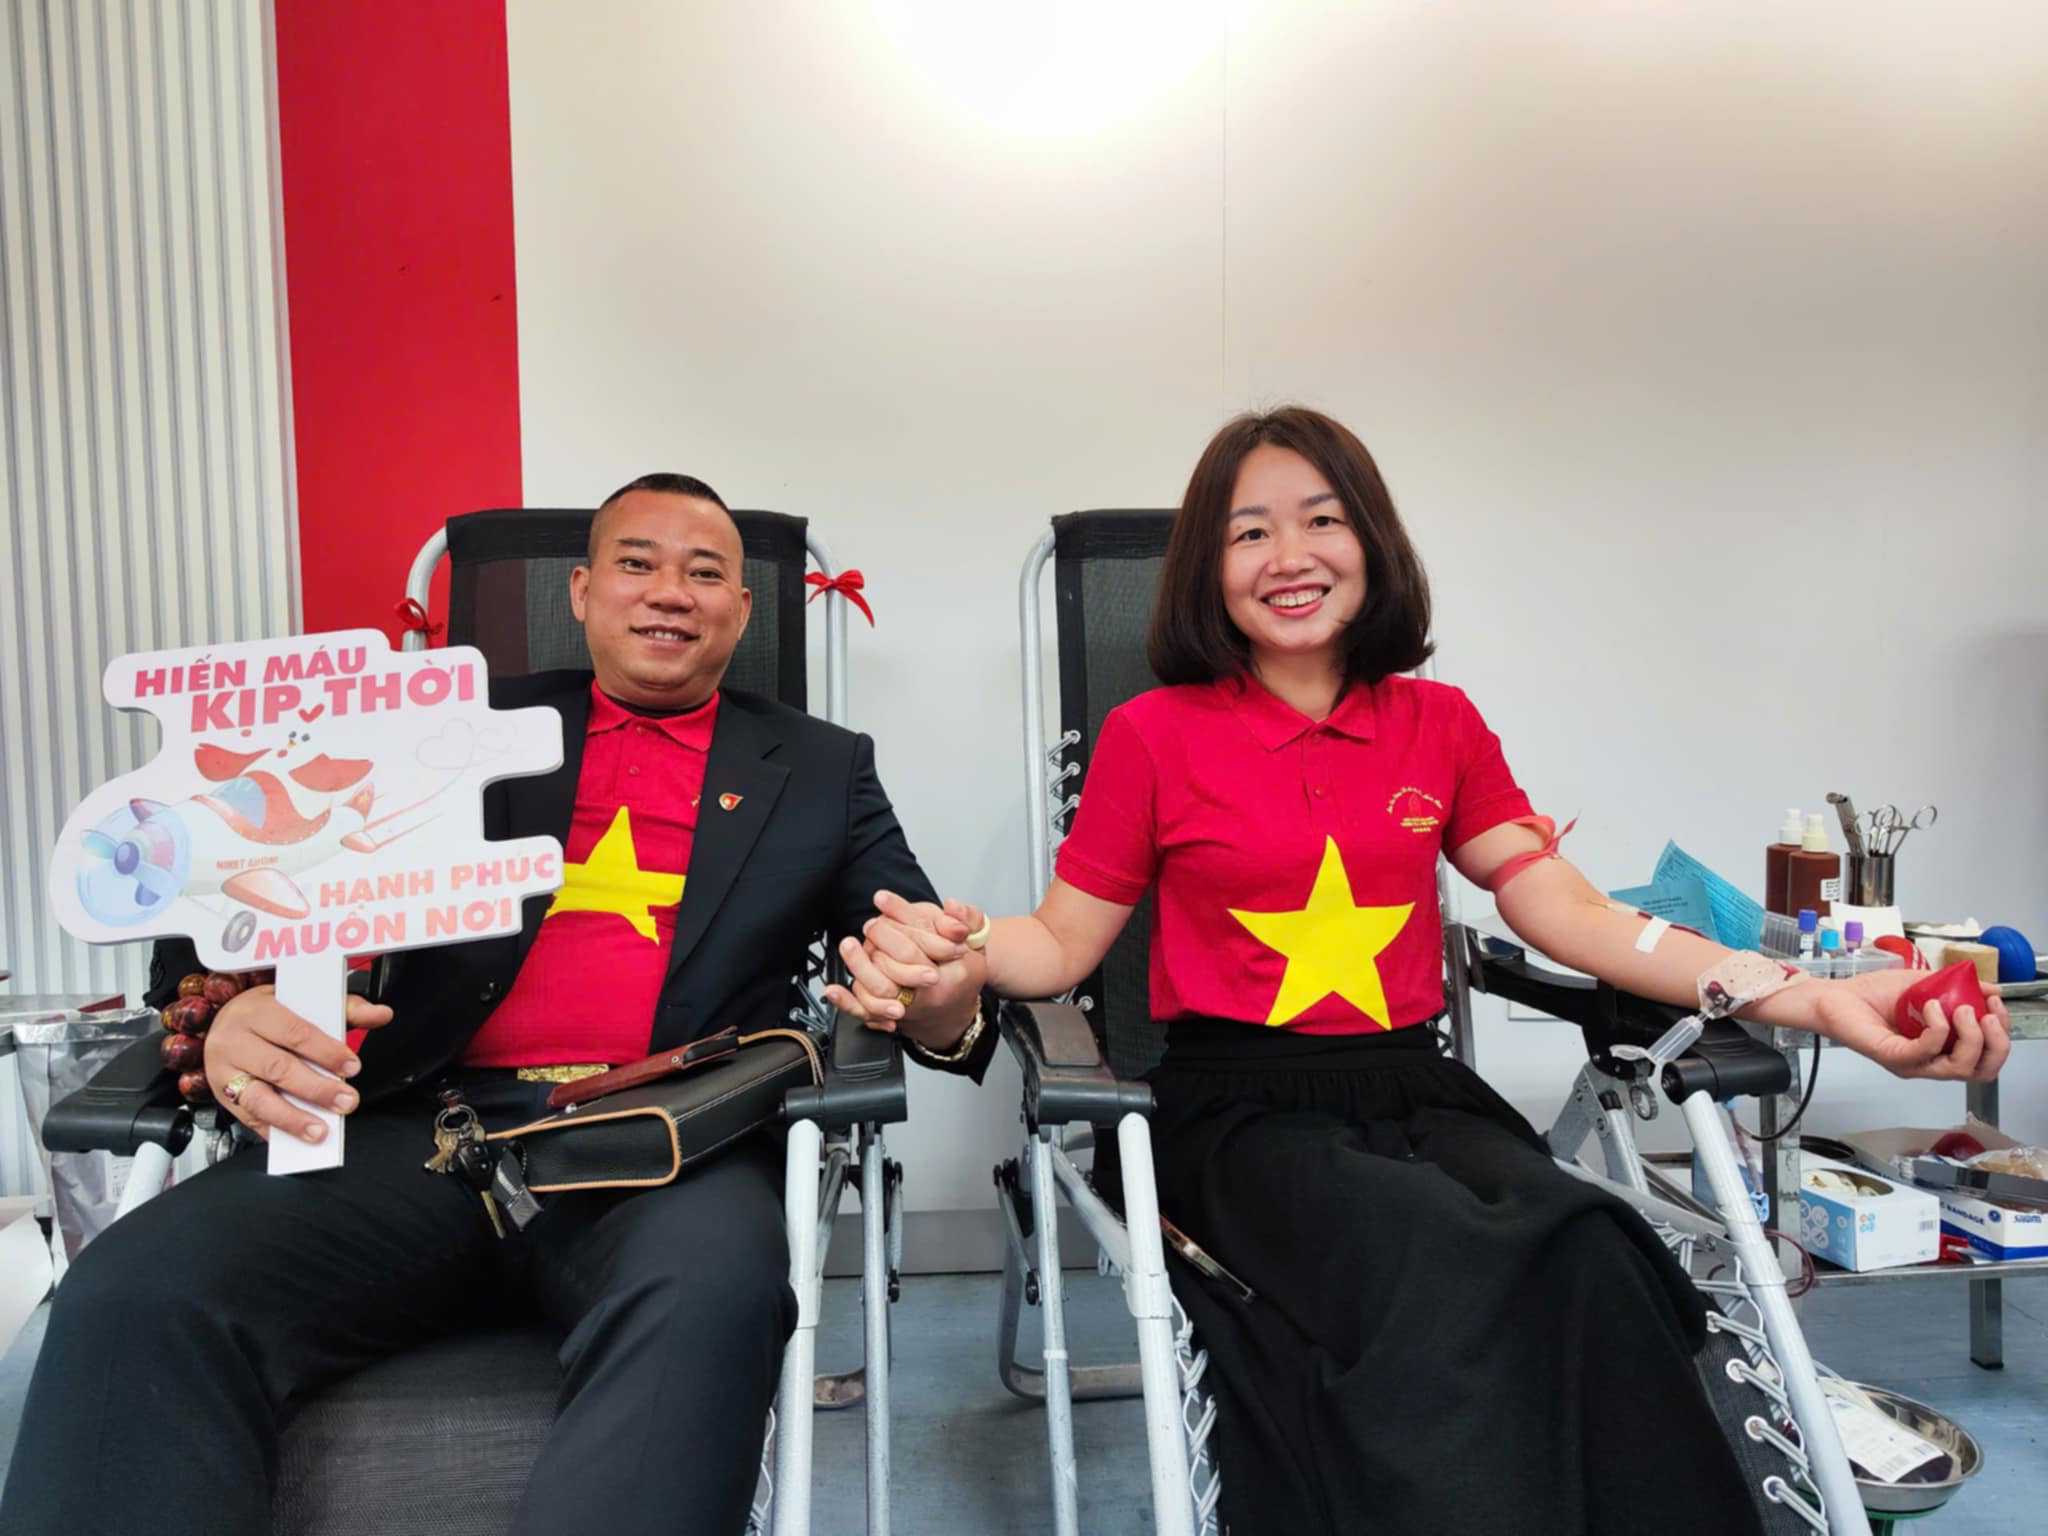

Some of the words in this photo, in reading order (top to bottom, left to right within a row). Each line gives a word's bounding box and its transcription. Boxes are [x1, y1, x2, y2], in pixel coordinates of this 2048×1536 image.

[134, 653, 247, 698] HIẾN
[263, 644, 367, 684] MÁU
[191, 684, 302, 738] KỊP
[324, 658, 475, 717] THỜI
[319, 868, 434, 910] HẠNH
[254, 911, 407, 961] MUÔN
[425, 896, 513, 938] NƠI
